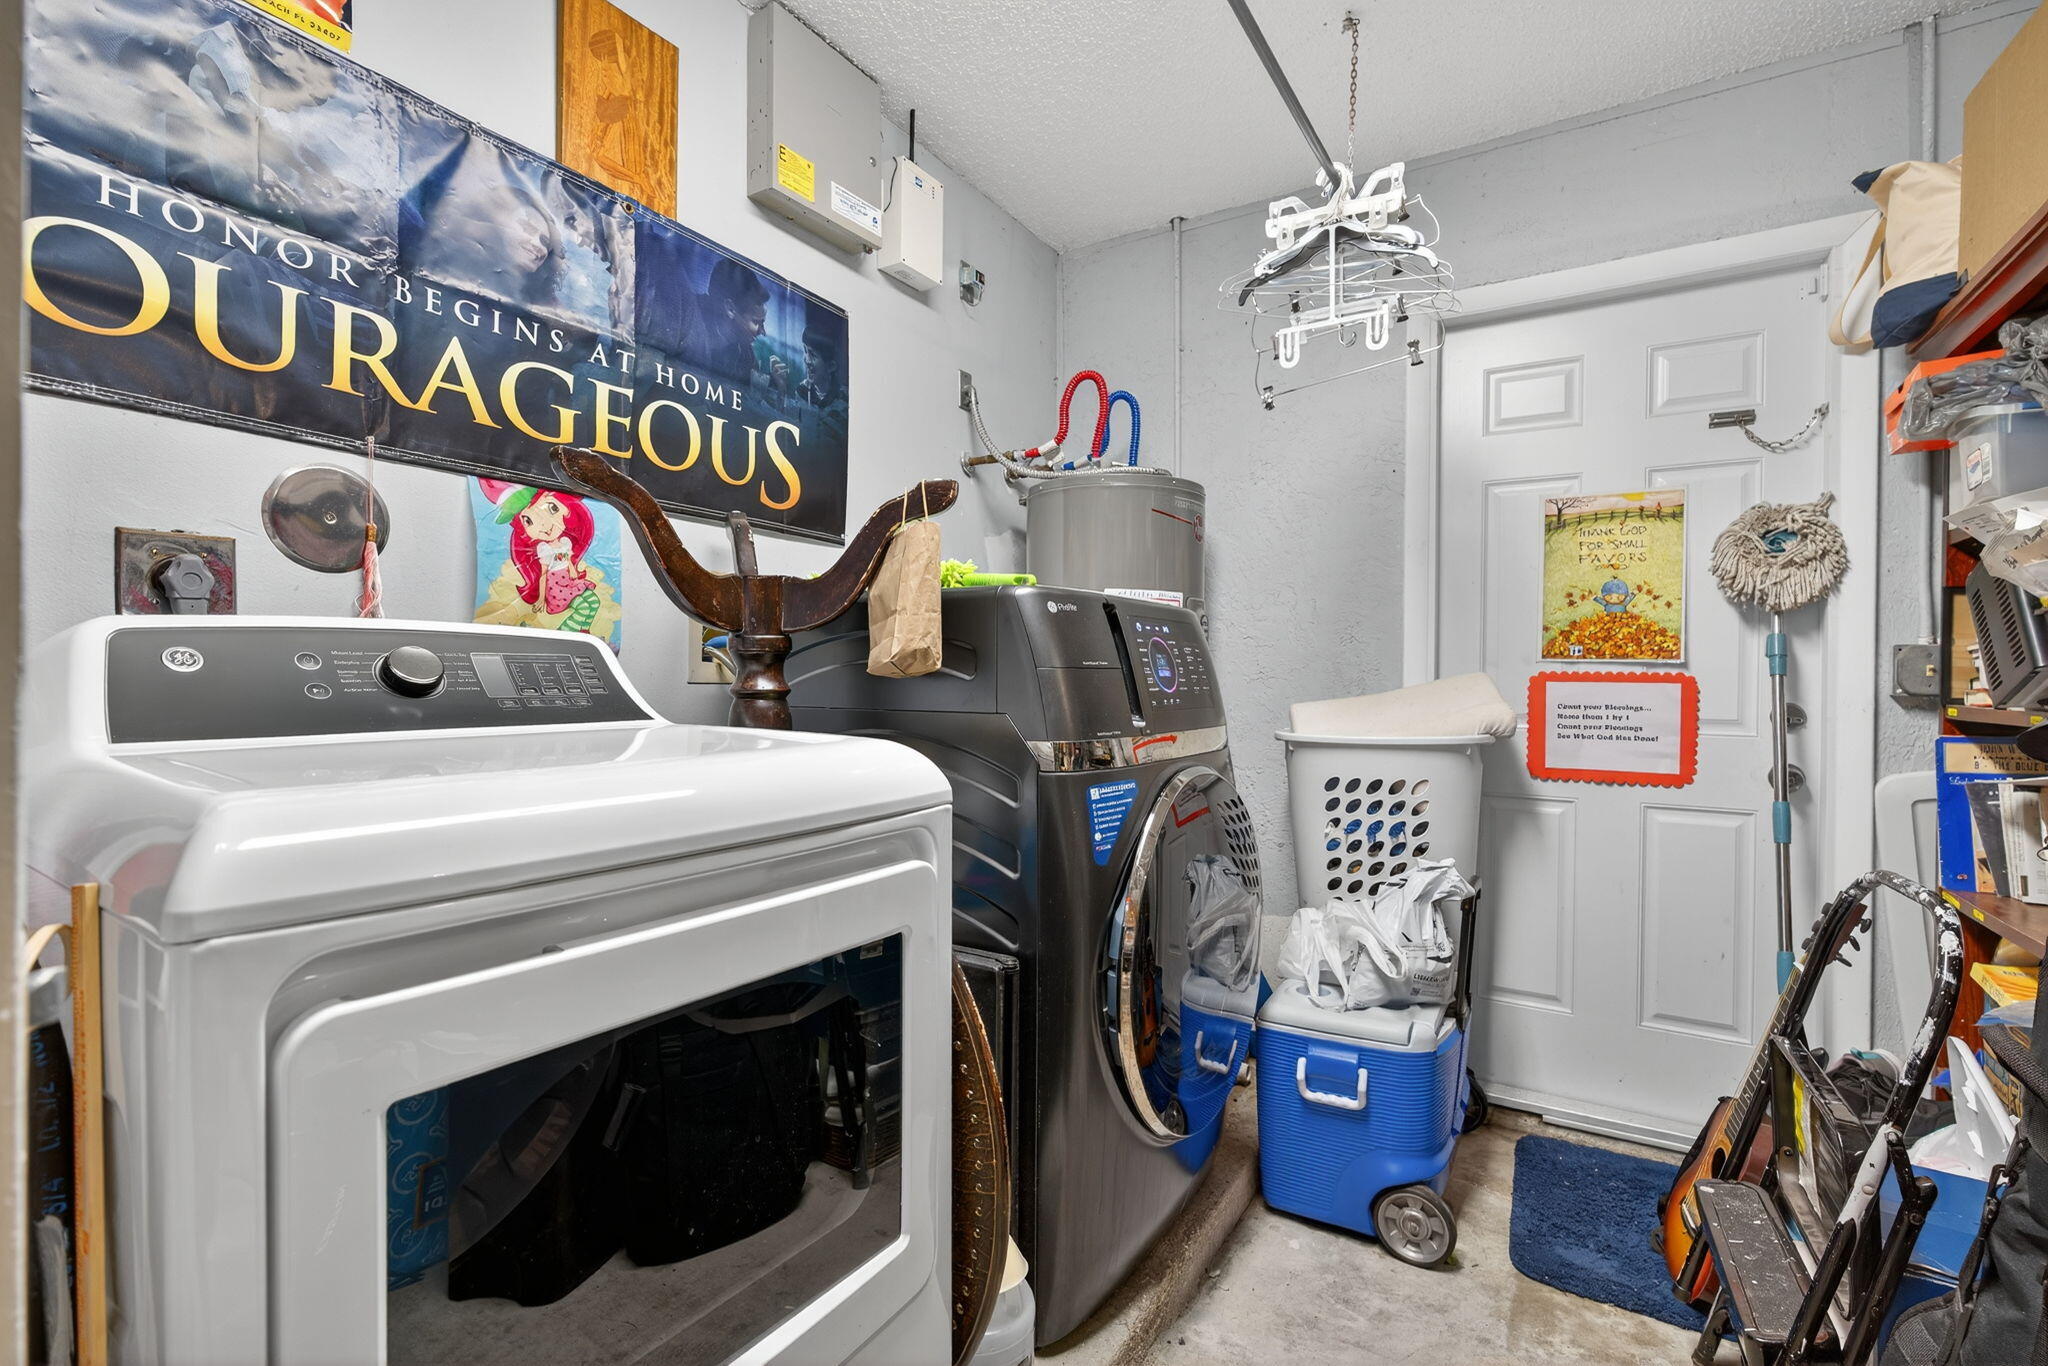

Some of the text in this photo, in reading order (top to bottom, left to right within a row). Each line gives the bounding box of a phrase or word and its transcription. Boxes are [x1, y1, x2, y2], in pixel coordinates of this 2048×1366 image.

[96, 174, 743, 411] HONOR BEGINS AT HOME
[1579, 525, 1648, 538] THANK GOD
[1579, 540, 1648, 551] FOR SMALL
[1579, 551, 1648, 564] FAVORS
[1557, 703, 1582, 711] Count
[1583, 704, 1602, 712] your
[1604, 723, 1644, 732] Blessings
[1573, 732, 1595, 741] What
[1597, 733, 1613, 741] God
